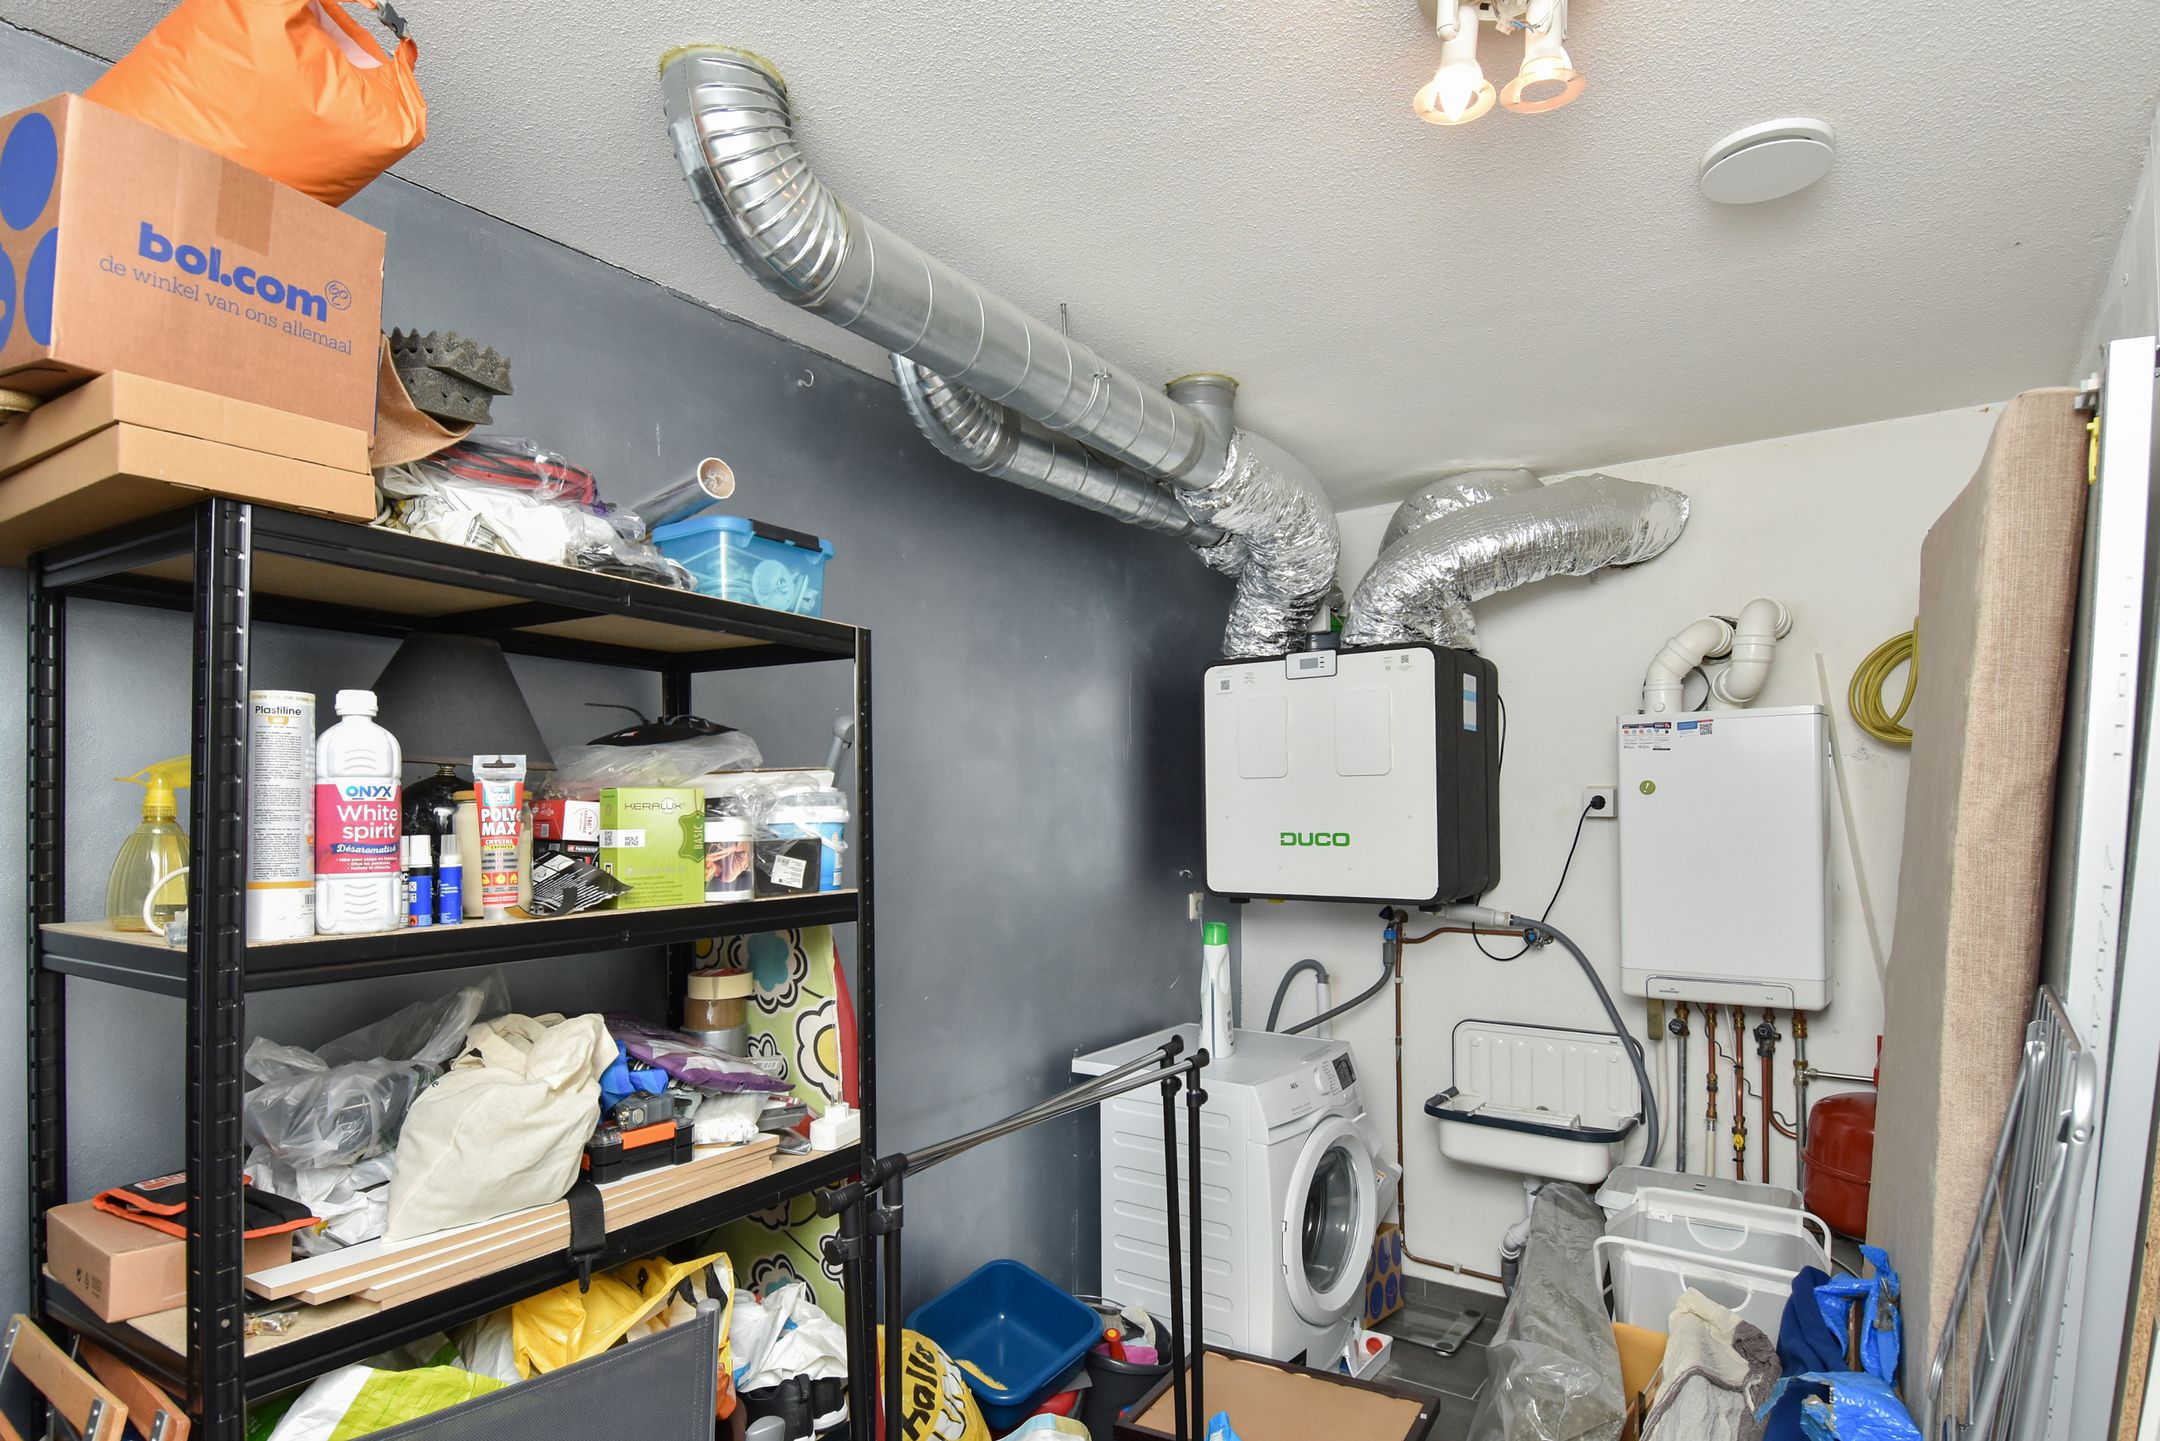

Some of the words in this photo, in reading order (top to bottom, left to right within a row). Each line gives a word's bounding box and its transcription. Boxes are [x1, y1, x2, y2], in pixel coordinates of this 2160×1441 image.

[138, 221, 328, 323] bol.com
[99, 255, 127, 278] de
[132, 265, 200, 302] winkel
[205, 291, 240, 316] van
[245, 306, 277, 329] ons
[282, 320, 352, 355] allemaal
[255, 705, 302, 716] Plastiline
[345, 785, 392, 798] ONYX
[336, 804, 398, 822] White
[624, 802, 683, 811] KERALUX
[481, 808, 518, 822] POLY
[342, 822, 395, 843] spirit
[481, 821, 517, 836] MAX
[693, 824, 703, 850] BASIC
[1279, 831, 1350, 847] DUCO
